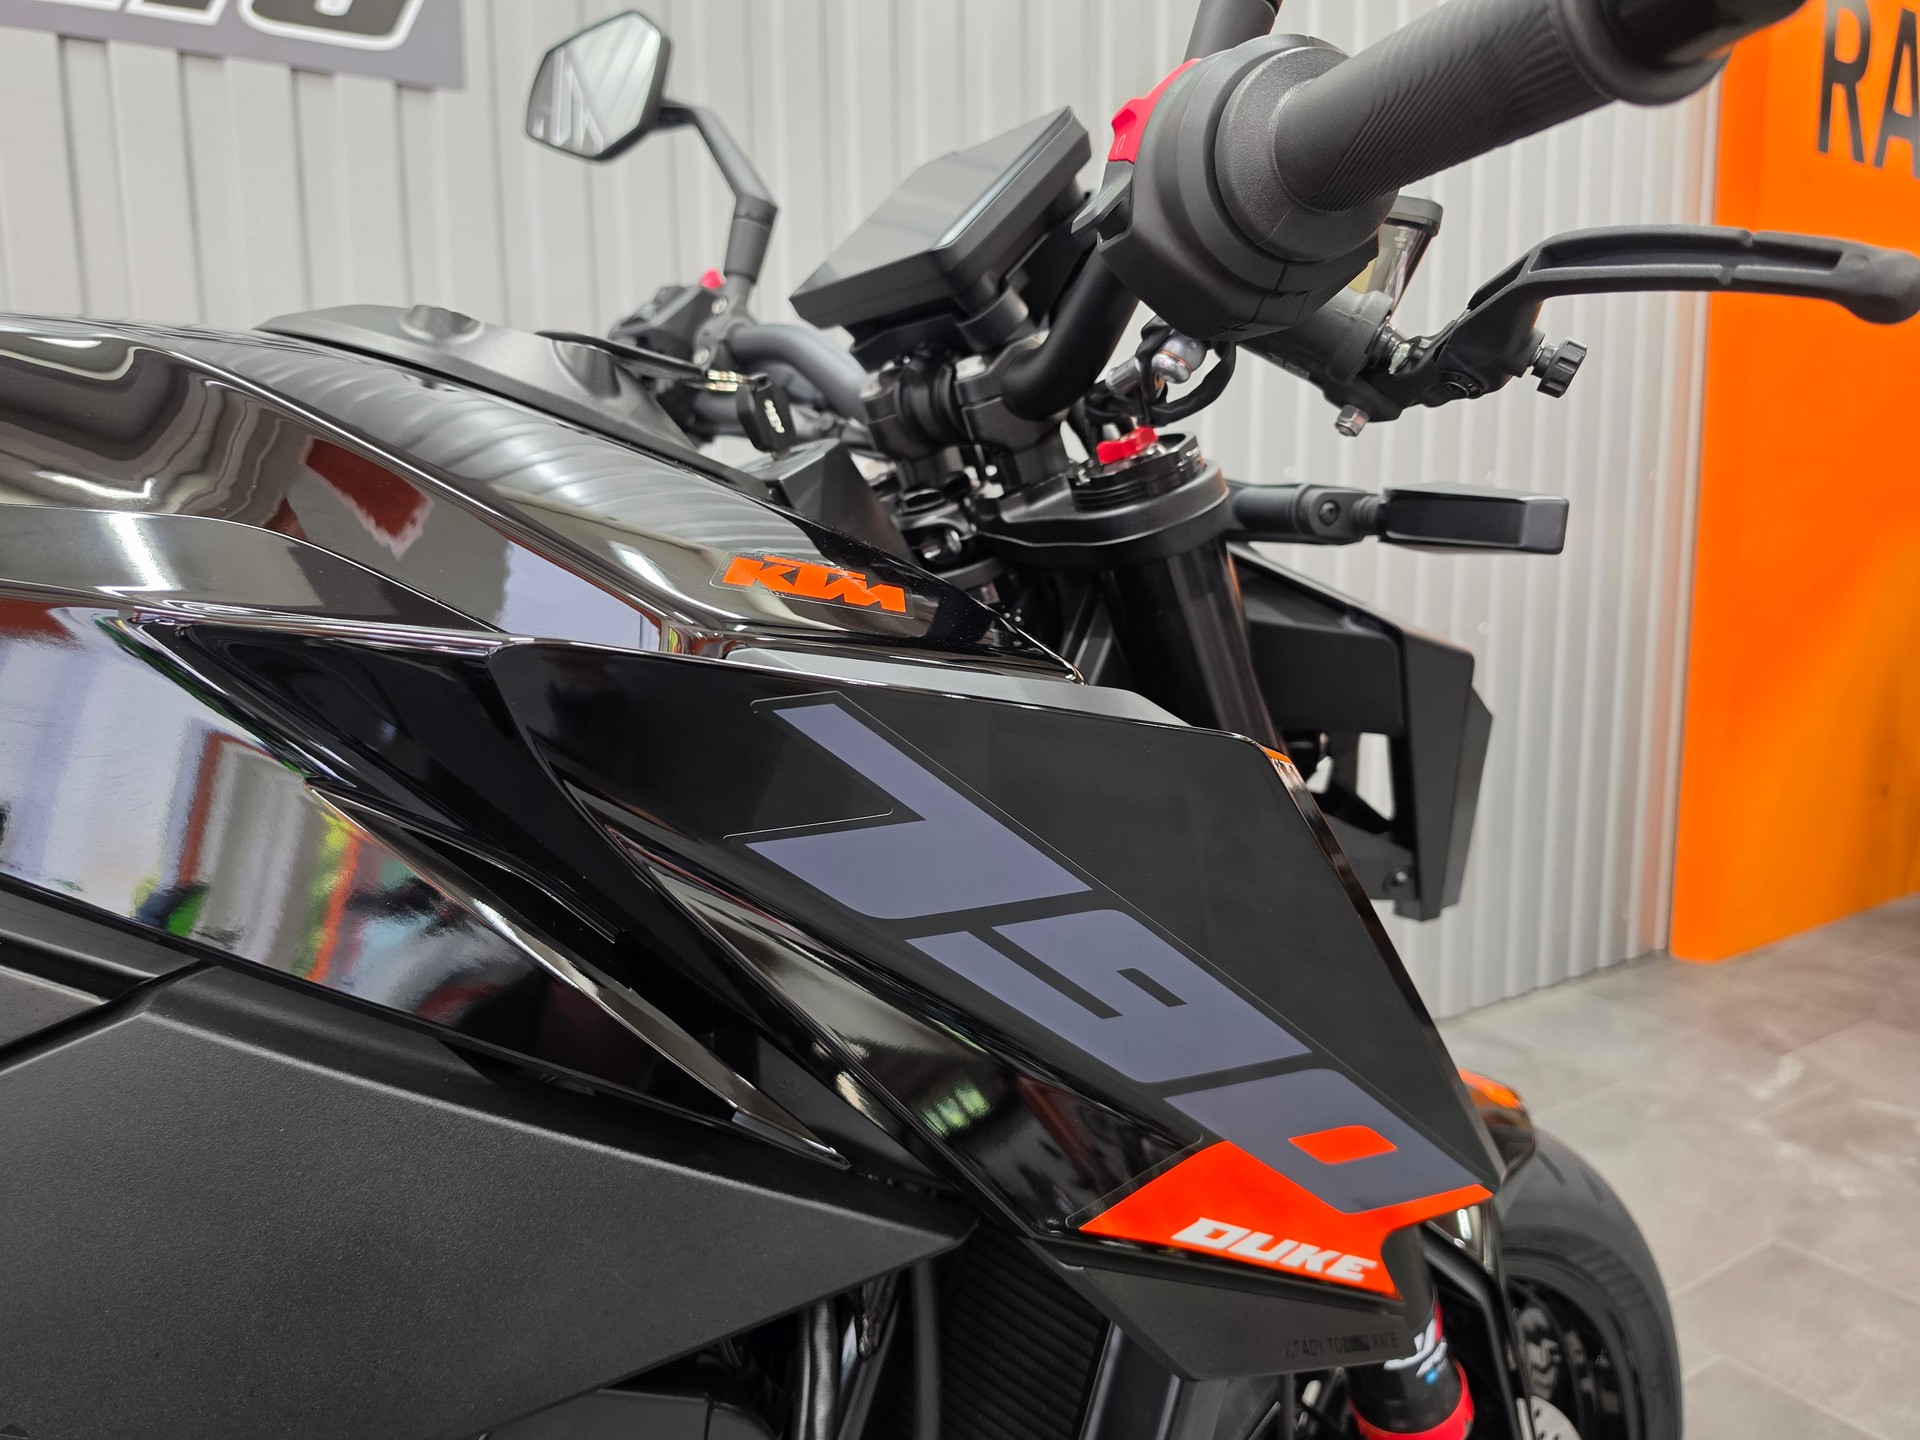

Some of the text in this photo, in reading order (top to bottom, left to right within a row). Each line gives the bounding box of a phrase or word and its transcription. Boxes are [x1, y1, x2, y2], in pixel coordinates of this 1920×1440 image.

[722, 555, 906, 613] KTM
[745, 703, 1484, 1214] 790
[1170, 1217, 1378, 1282] DUKE
